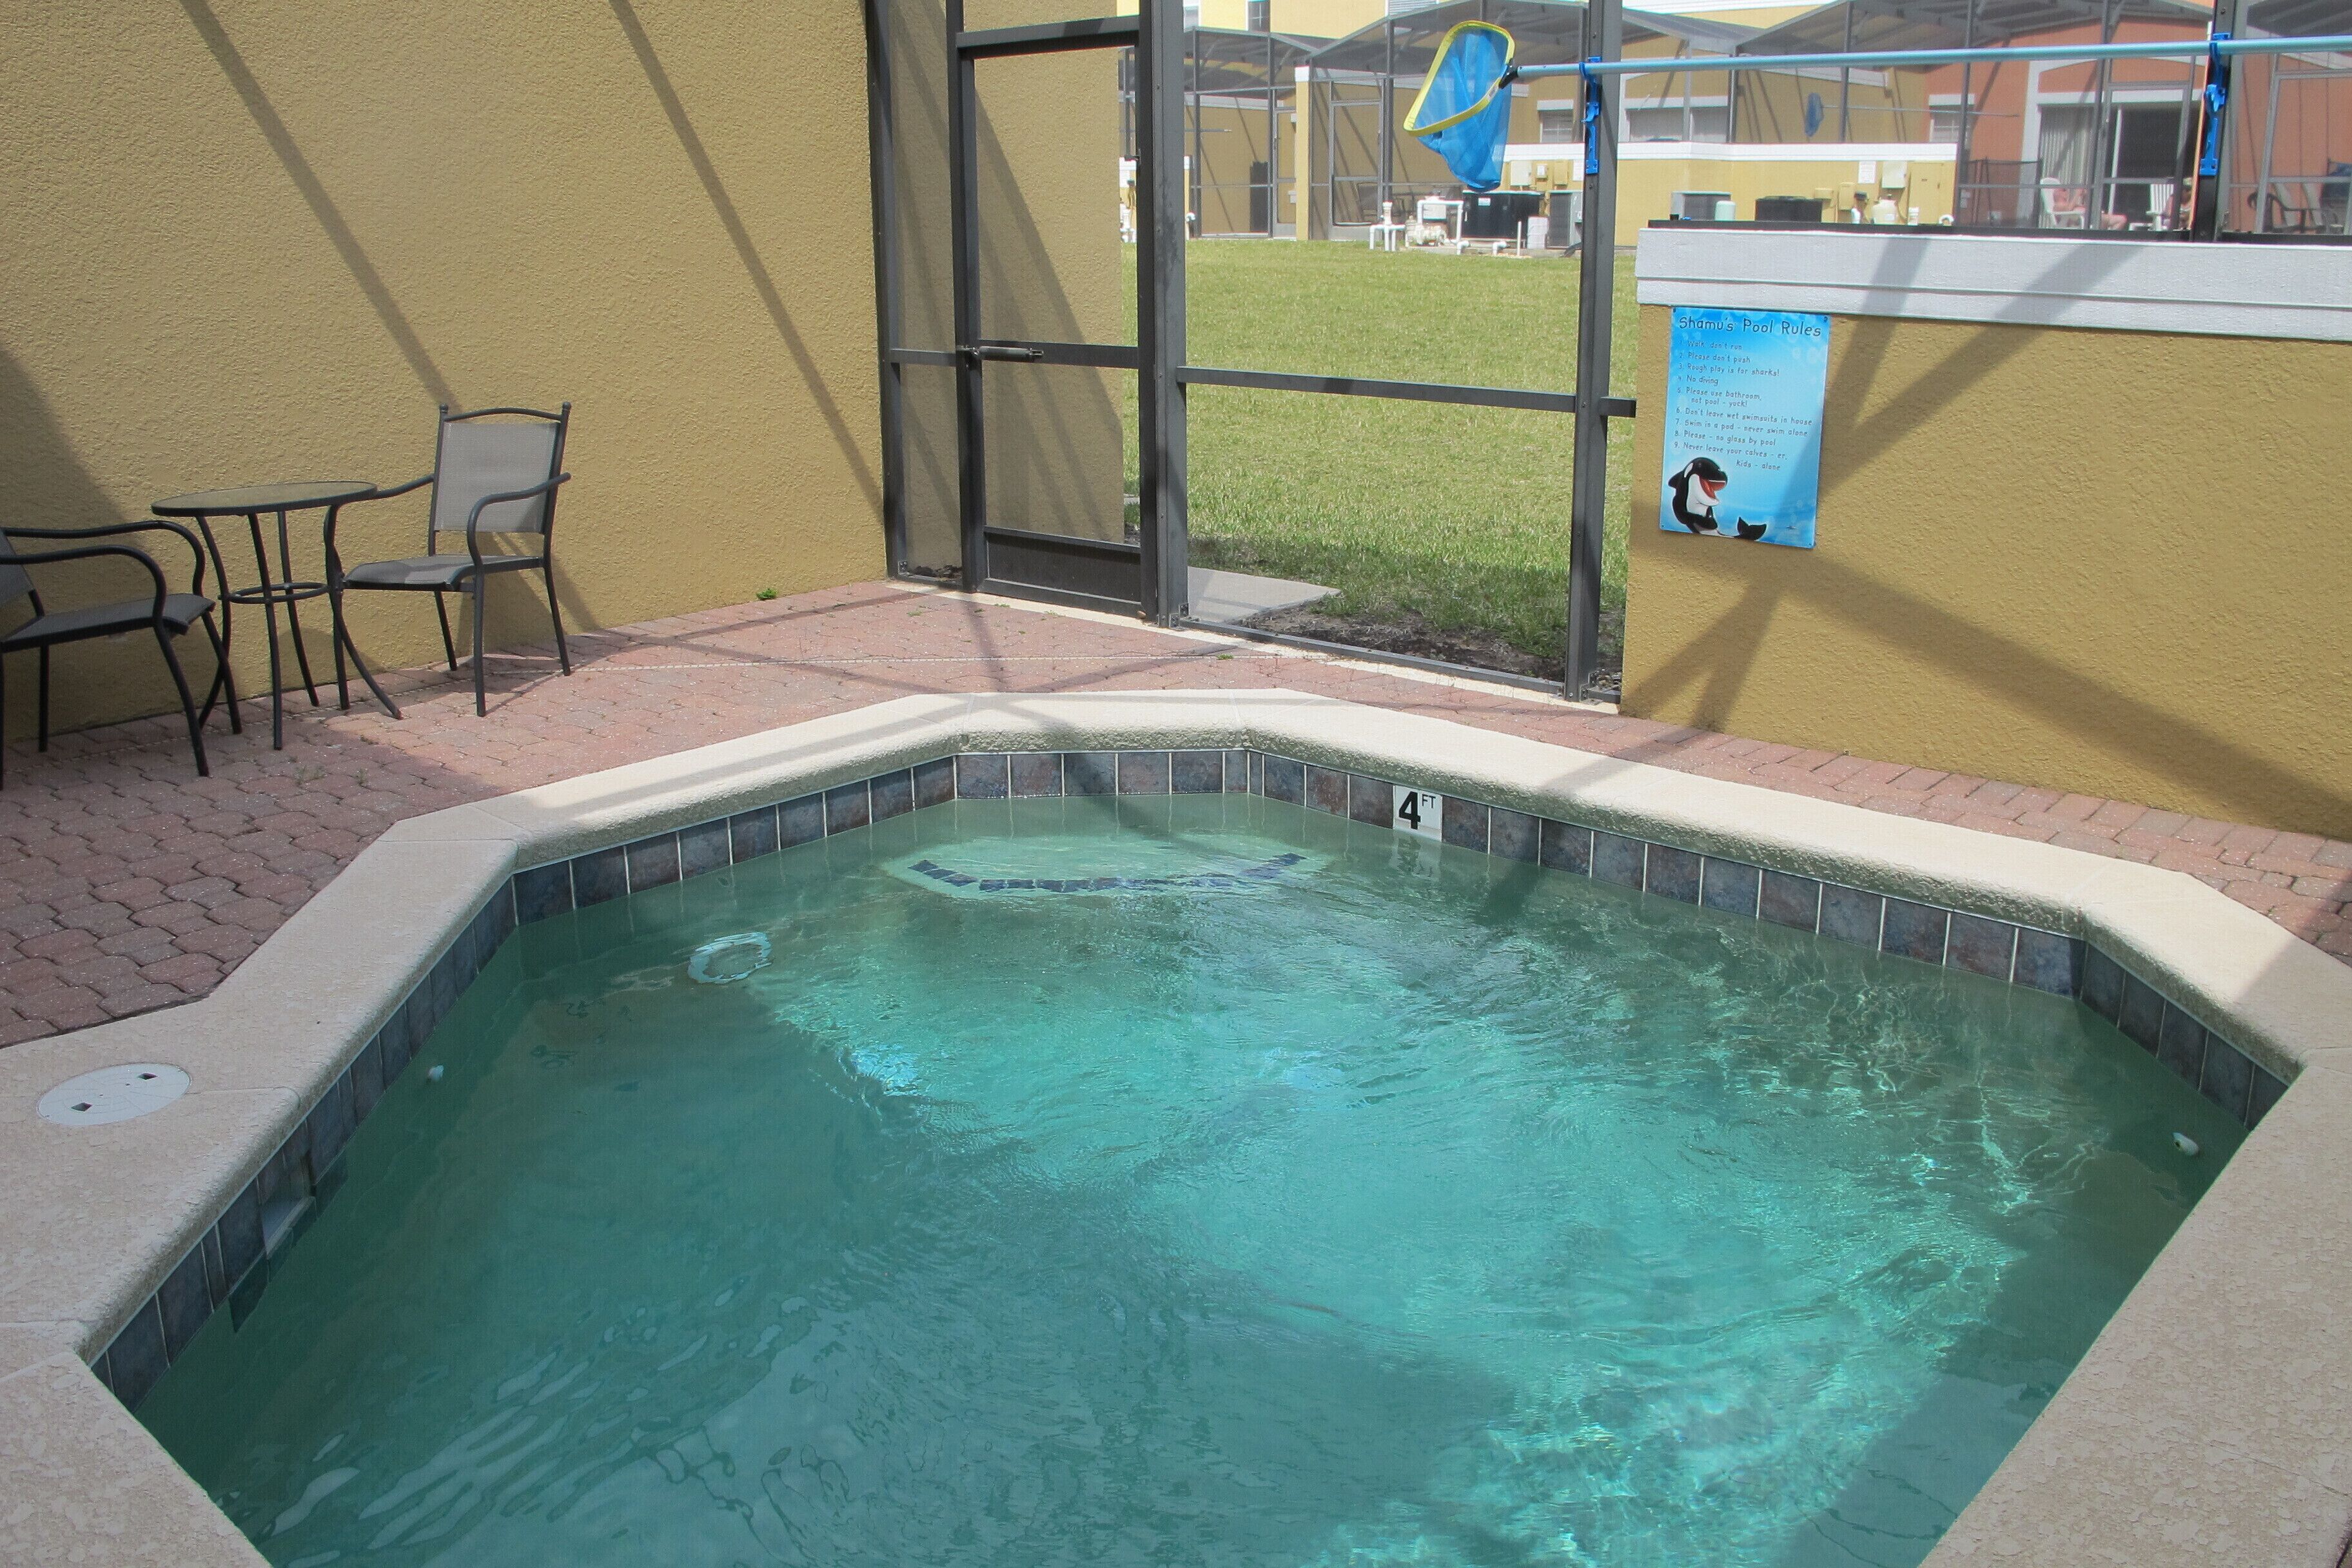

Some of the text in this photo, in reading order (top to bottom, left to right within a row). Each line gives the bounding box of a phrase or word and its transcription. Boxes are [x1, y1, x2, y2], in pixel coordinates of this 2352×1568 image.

[1680, 317, 1821, 337] Shamu's Pool Rules
[1688, 351, 1710, 360] Please
[1687, 363, 1707, 373] Rough
[1710, 366, 1725, 374] play
[1751, 368, 1780, 377] sharks!
[1699, 377, 1719, 387] diving
[1686, 387, 1709, 395] Please
[1685, 407, 1703, 416] Don't
[1706, 409, 1723, 418] leave
[1742, 413, 1778, 423] swimsuits
[1790, 416, 1812, 426] house
[1684, 430, 1706, 440] Please
[1727, 435, 1745, 444] glass
[1749, 437, 1758, 446] by
[1683, 442, 1703, 451] Never
[1706, 444, 1724, 453] leave
[1745, 449, 1767, 457] calves
[1761, 462, 1781, 471] alone
[1398, 790, 1436, 830] 4 FT
